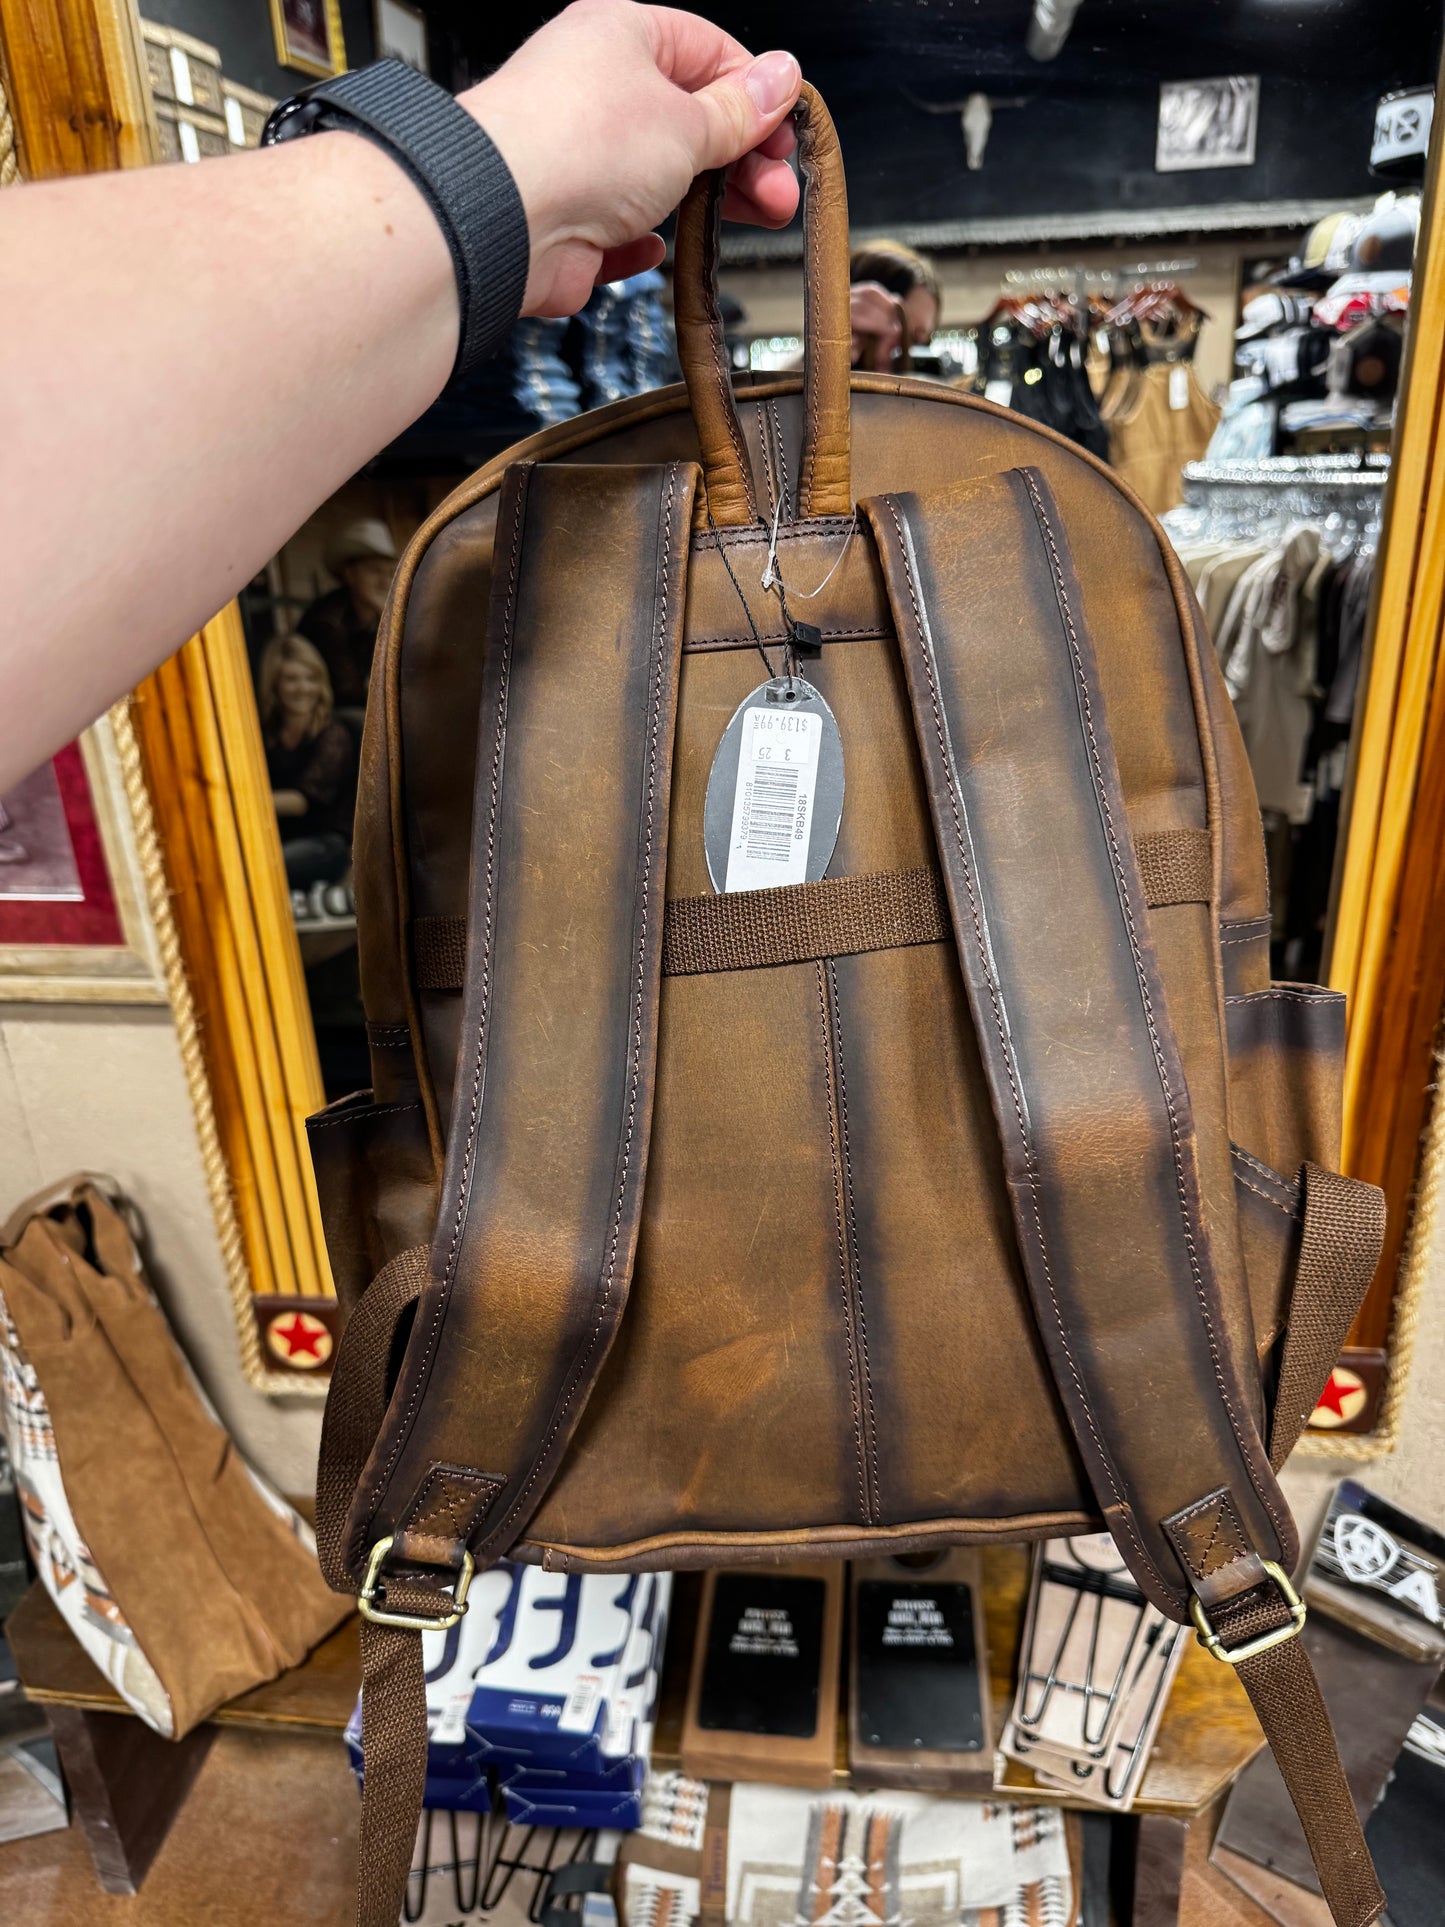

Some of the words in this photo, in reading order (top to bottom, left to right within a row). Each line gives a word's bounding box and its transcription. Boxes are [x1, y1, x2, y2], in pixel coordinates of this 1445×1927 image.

[760, 714, 808, 732] $139.99
[758, 747, 772, 760] 25
[784, 748, 792, 761] 3
[794, 793, 808, 841] 18SKB49
